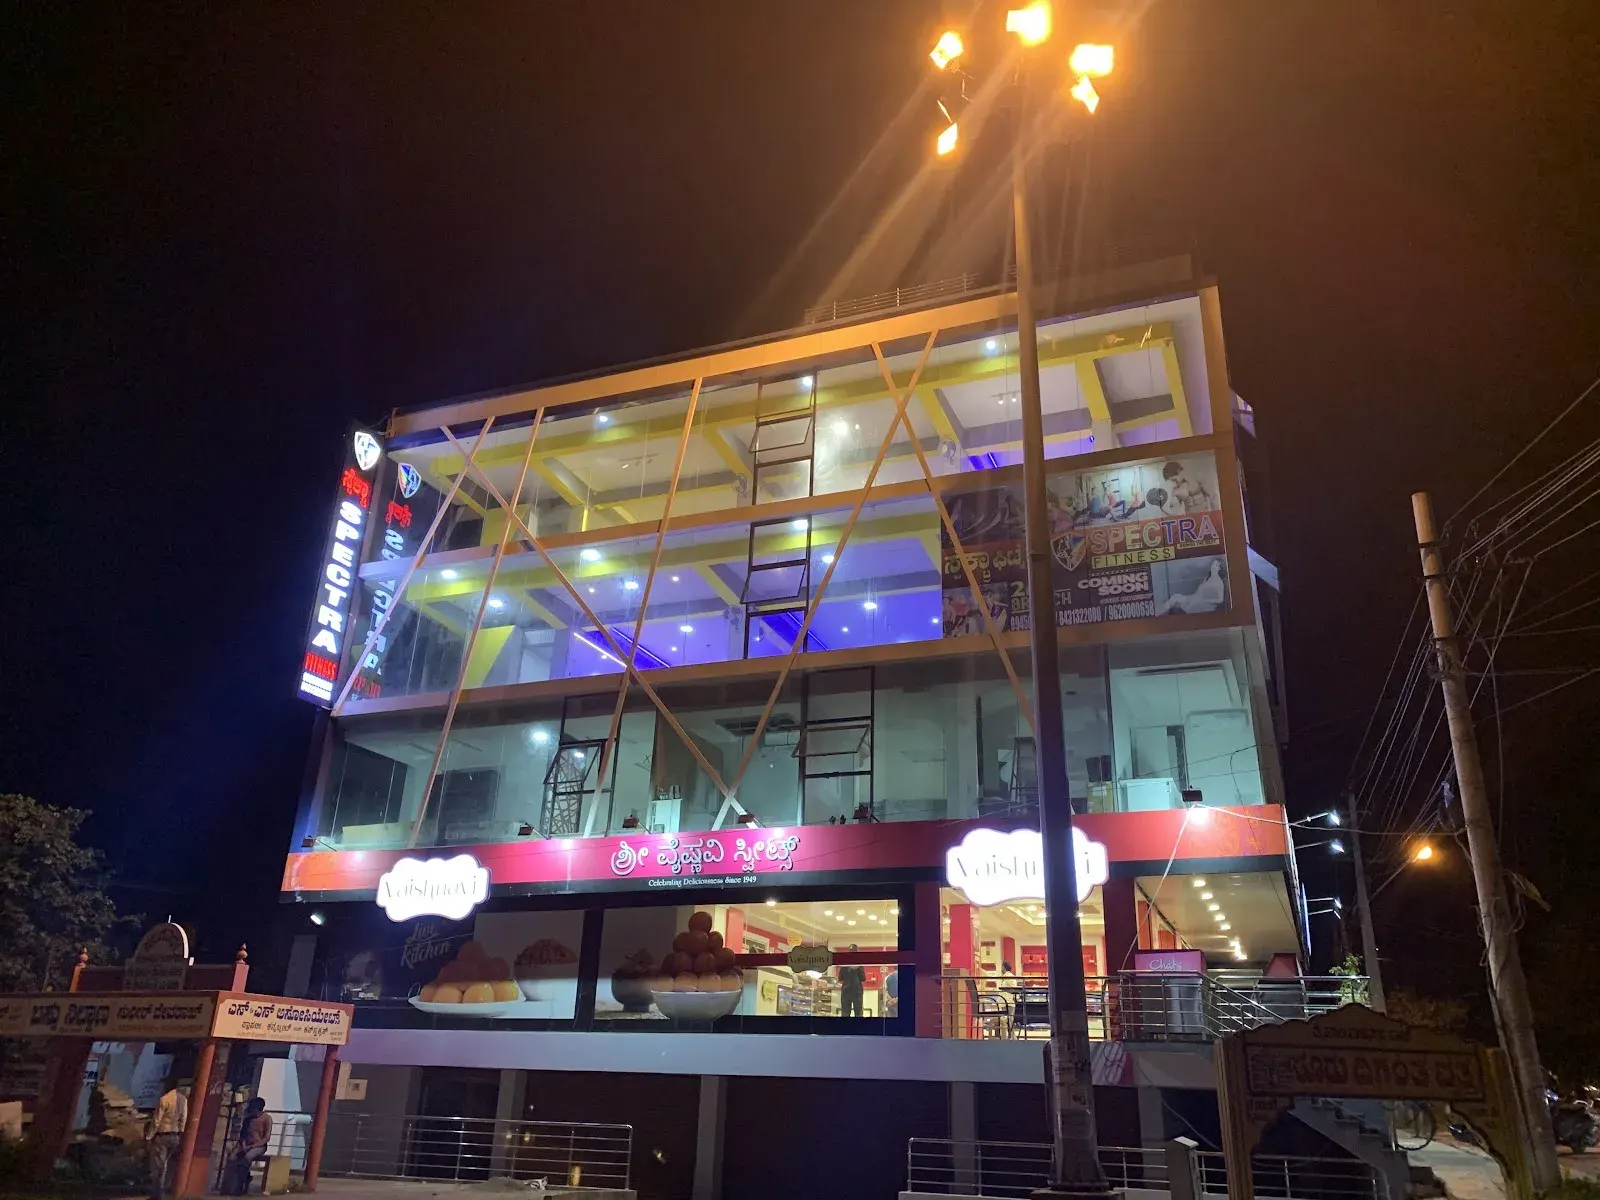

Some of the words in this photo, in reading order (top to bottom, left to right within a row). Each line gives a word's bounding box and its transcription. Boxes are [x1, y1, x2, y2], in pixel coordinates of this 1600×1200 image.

[1090, 516, 1219, 555] SPECTRA
[1094, 547, 1172, 568] FITNESS
[311, 500, 363, 655] SPECTRA
[1077, 571, 1149, 590] COMING
[1099, 581, 1150, 597] SOON
[610, 841, 649, 876] ಶ್ರೀ
[656, 837, 724, 875] ವೈಷ್ಣವಿ
[733, 834, 801, 872] ಸ್ವೀಟ್ಸ್
[385, 876, 477, 899] Vaishnavi
[743, 875, 757, 885] 1949
[1150, 958, 1182, 970] Chats
[228, 1001, 250, 1016] ಎಸ್
[254, 1004, 275, 1017] ಎಸ್
